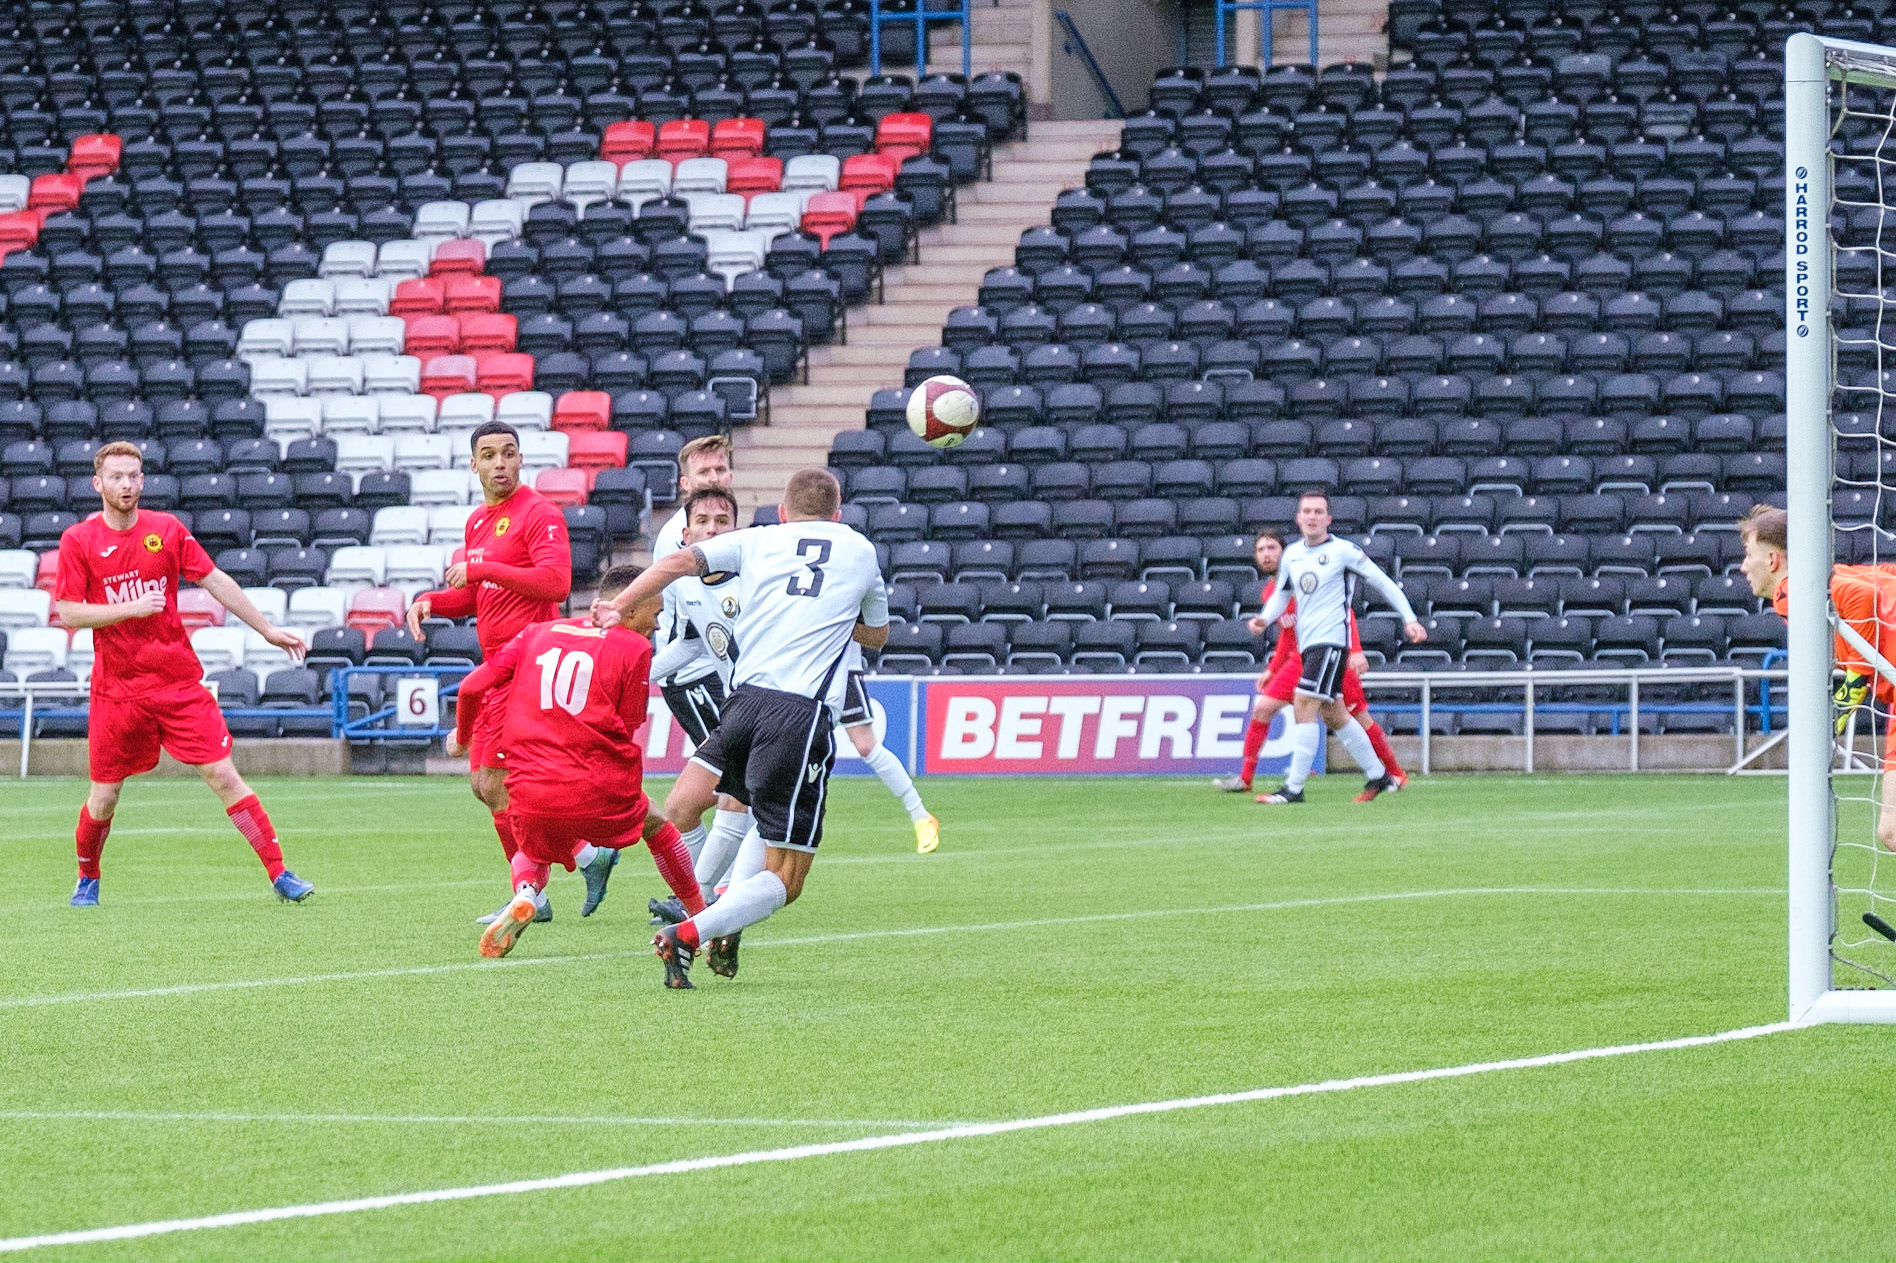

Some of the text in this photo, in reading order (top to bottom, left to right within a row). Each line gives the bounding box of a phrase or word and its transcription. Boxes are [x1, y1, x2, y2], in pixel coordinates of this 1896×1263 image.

[1796, 183, 1809, 321] HARROD SPORT
[103, 569, 139, 585] STEWART
[786, 538, 832, 597] 3
[104, 575, 168, 605] Milne
[409, 687, 426, 716] 6
[535, 647, 594, 716] 10
